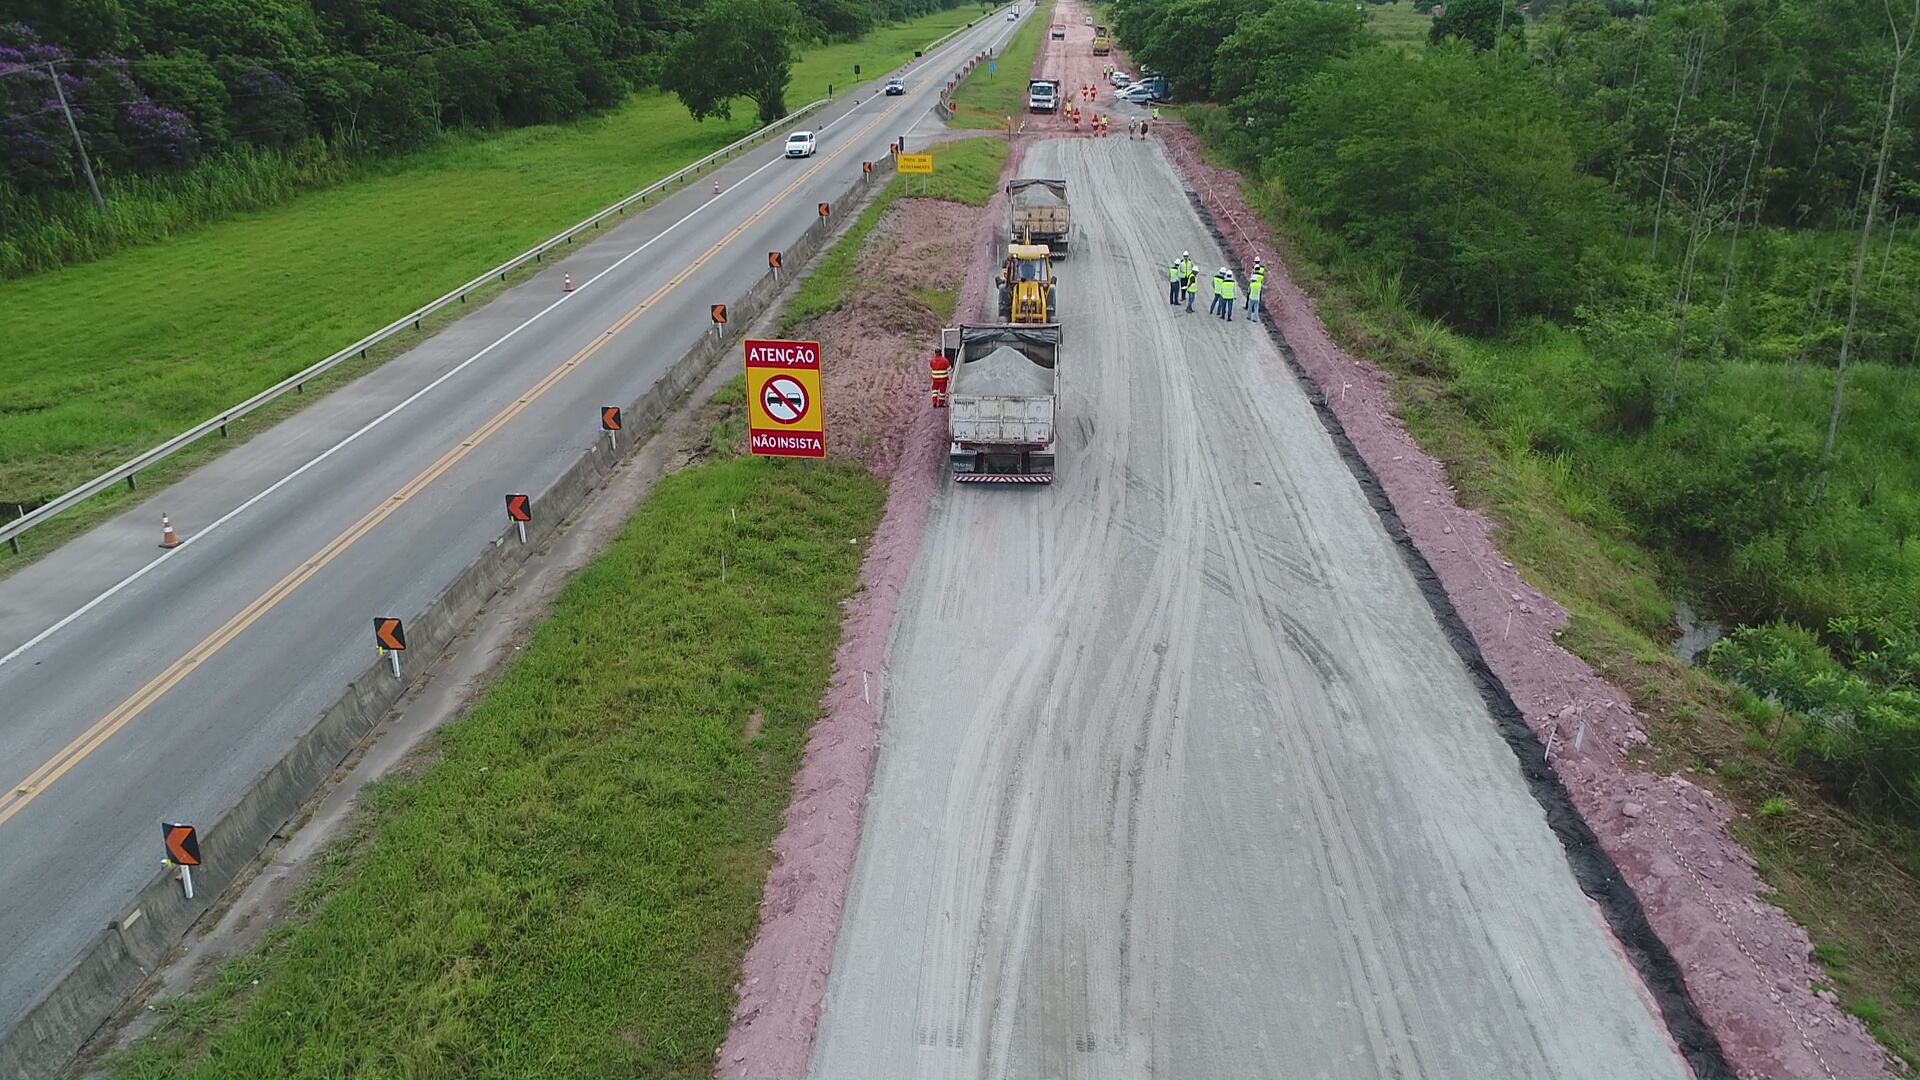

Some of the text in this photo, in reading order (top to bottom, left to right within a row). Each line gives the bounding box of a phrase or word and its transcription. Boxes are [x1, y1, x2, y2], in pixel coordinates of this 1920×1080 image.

[749, 346, 815, 365] ATENÇÃO
[752, 434, 822, 450] NÃO INSISTA
